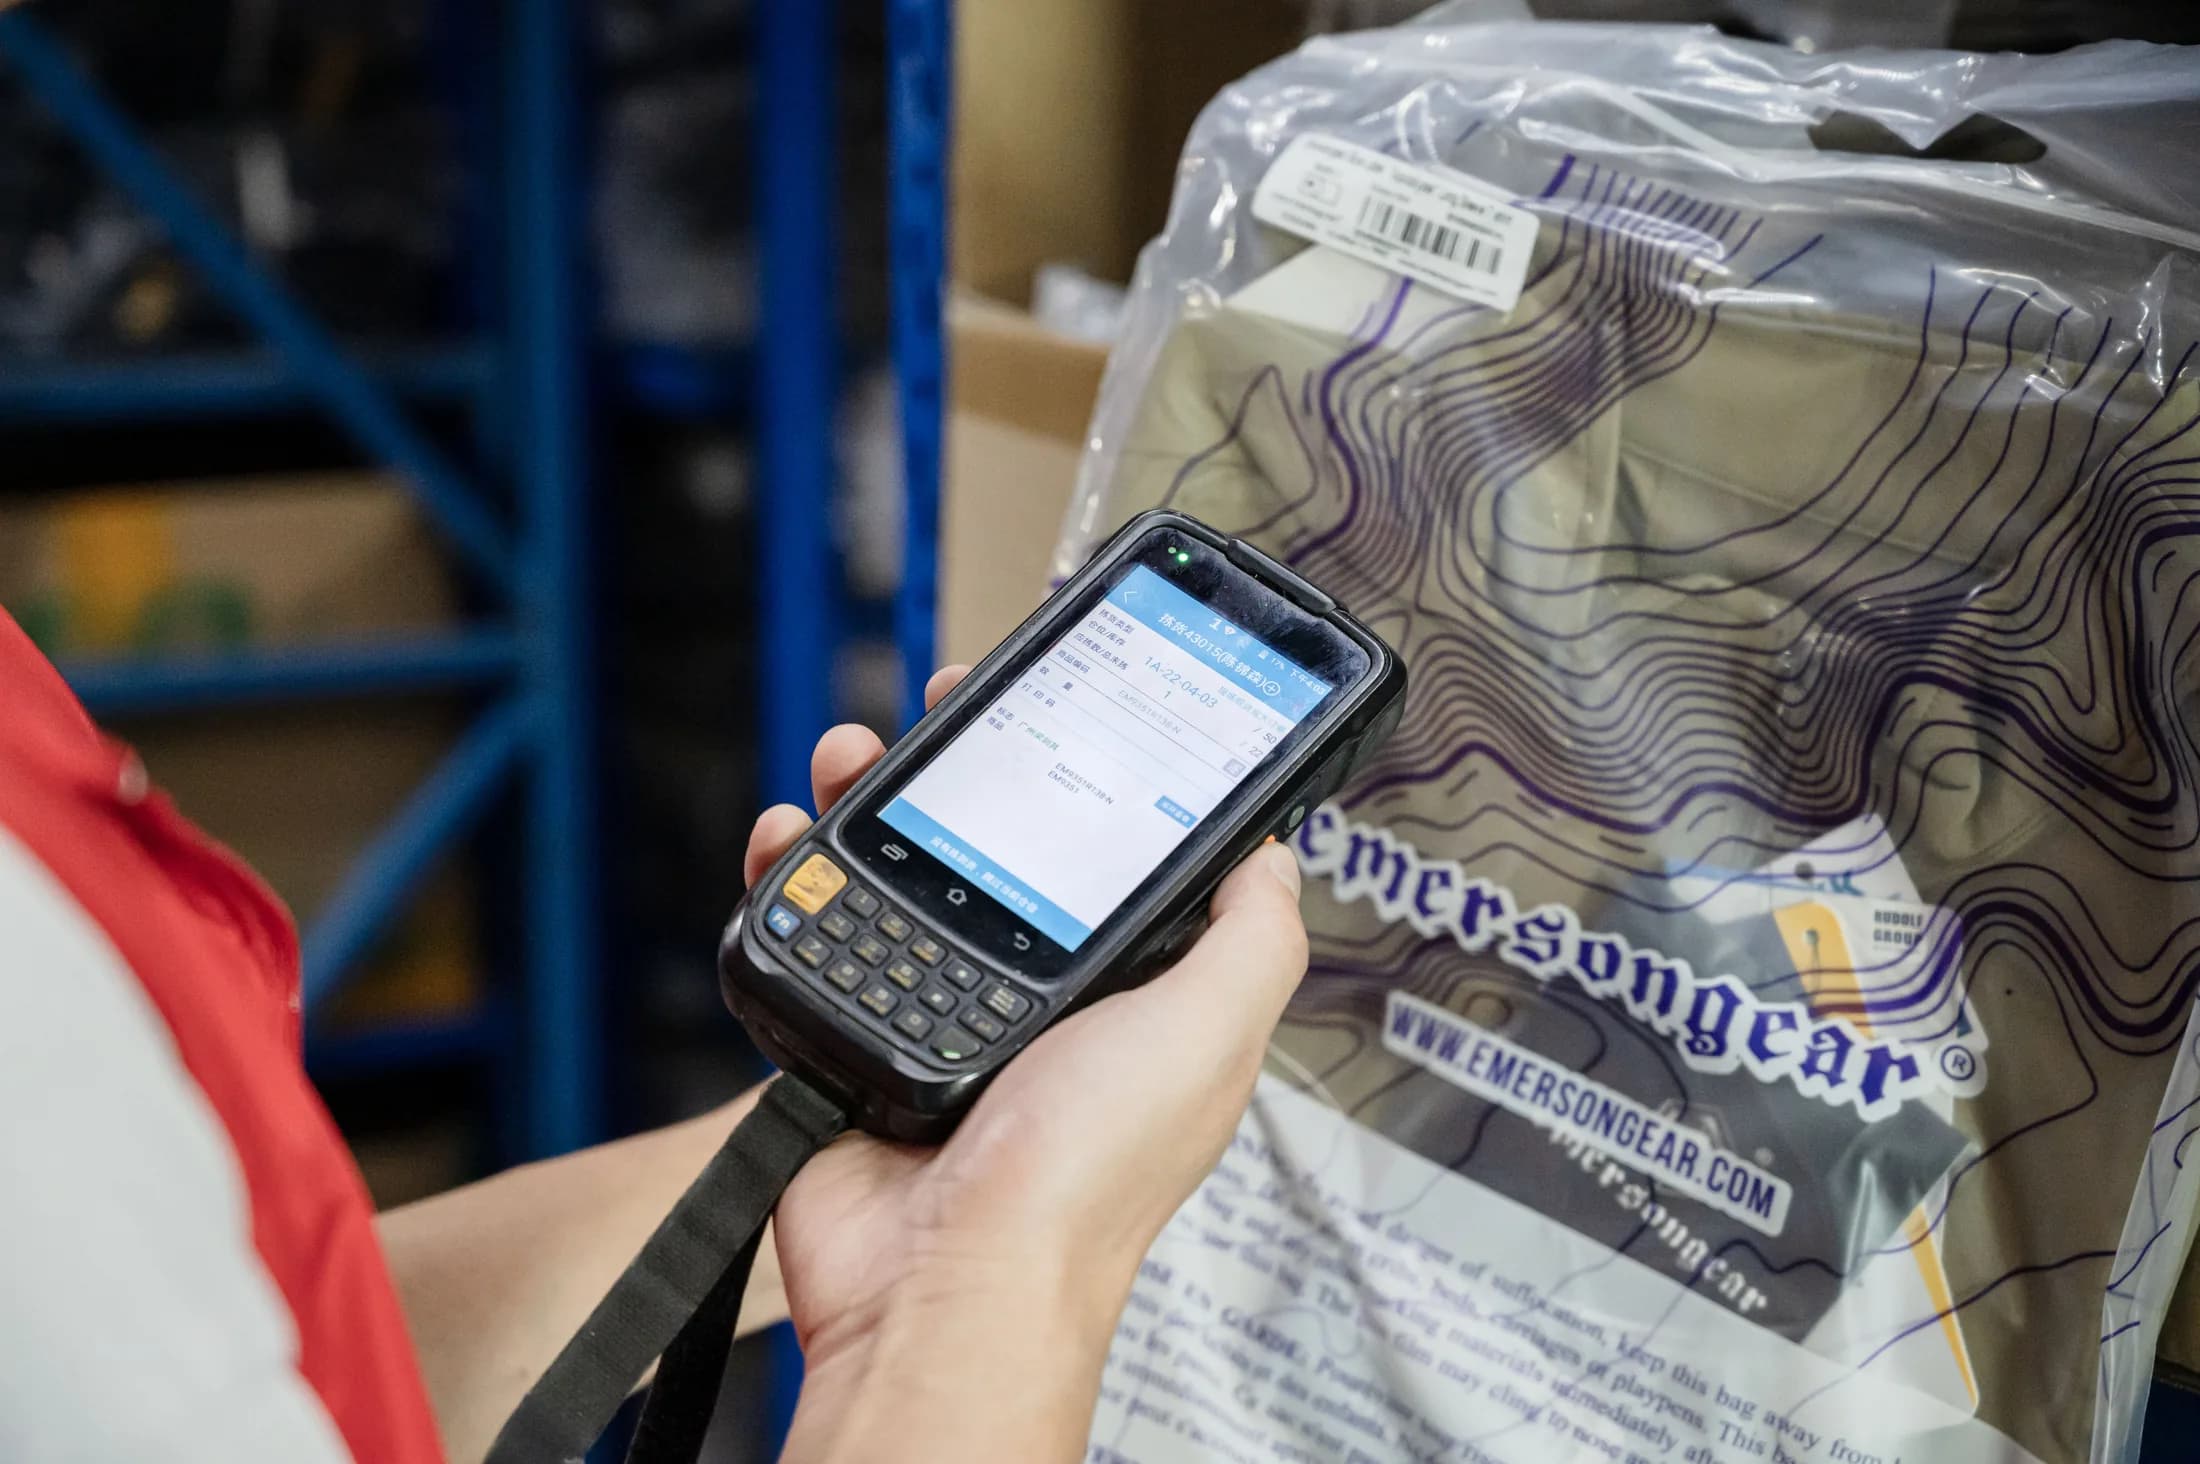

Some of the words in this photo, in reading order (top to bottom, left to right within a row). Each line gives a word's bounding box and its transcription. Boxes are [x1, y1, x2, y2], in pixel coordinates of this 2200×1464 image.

[1141, 655, 1220, 709] 1A-22-04-03
[771, 909, 793, 930] Fn
[1392, 1006, 1776, 1218] WWW.EMERSONGEAR.COM
[1668, 1359, 1714, 1396] this
[1712, 1382, 1760, 1421] bag
[1763, 1409, 1822, 1451] away
[1719, 1419, 1767, 1456] This
